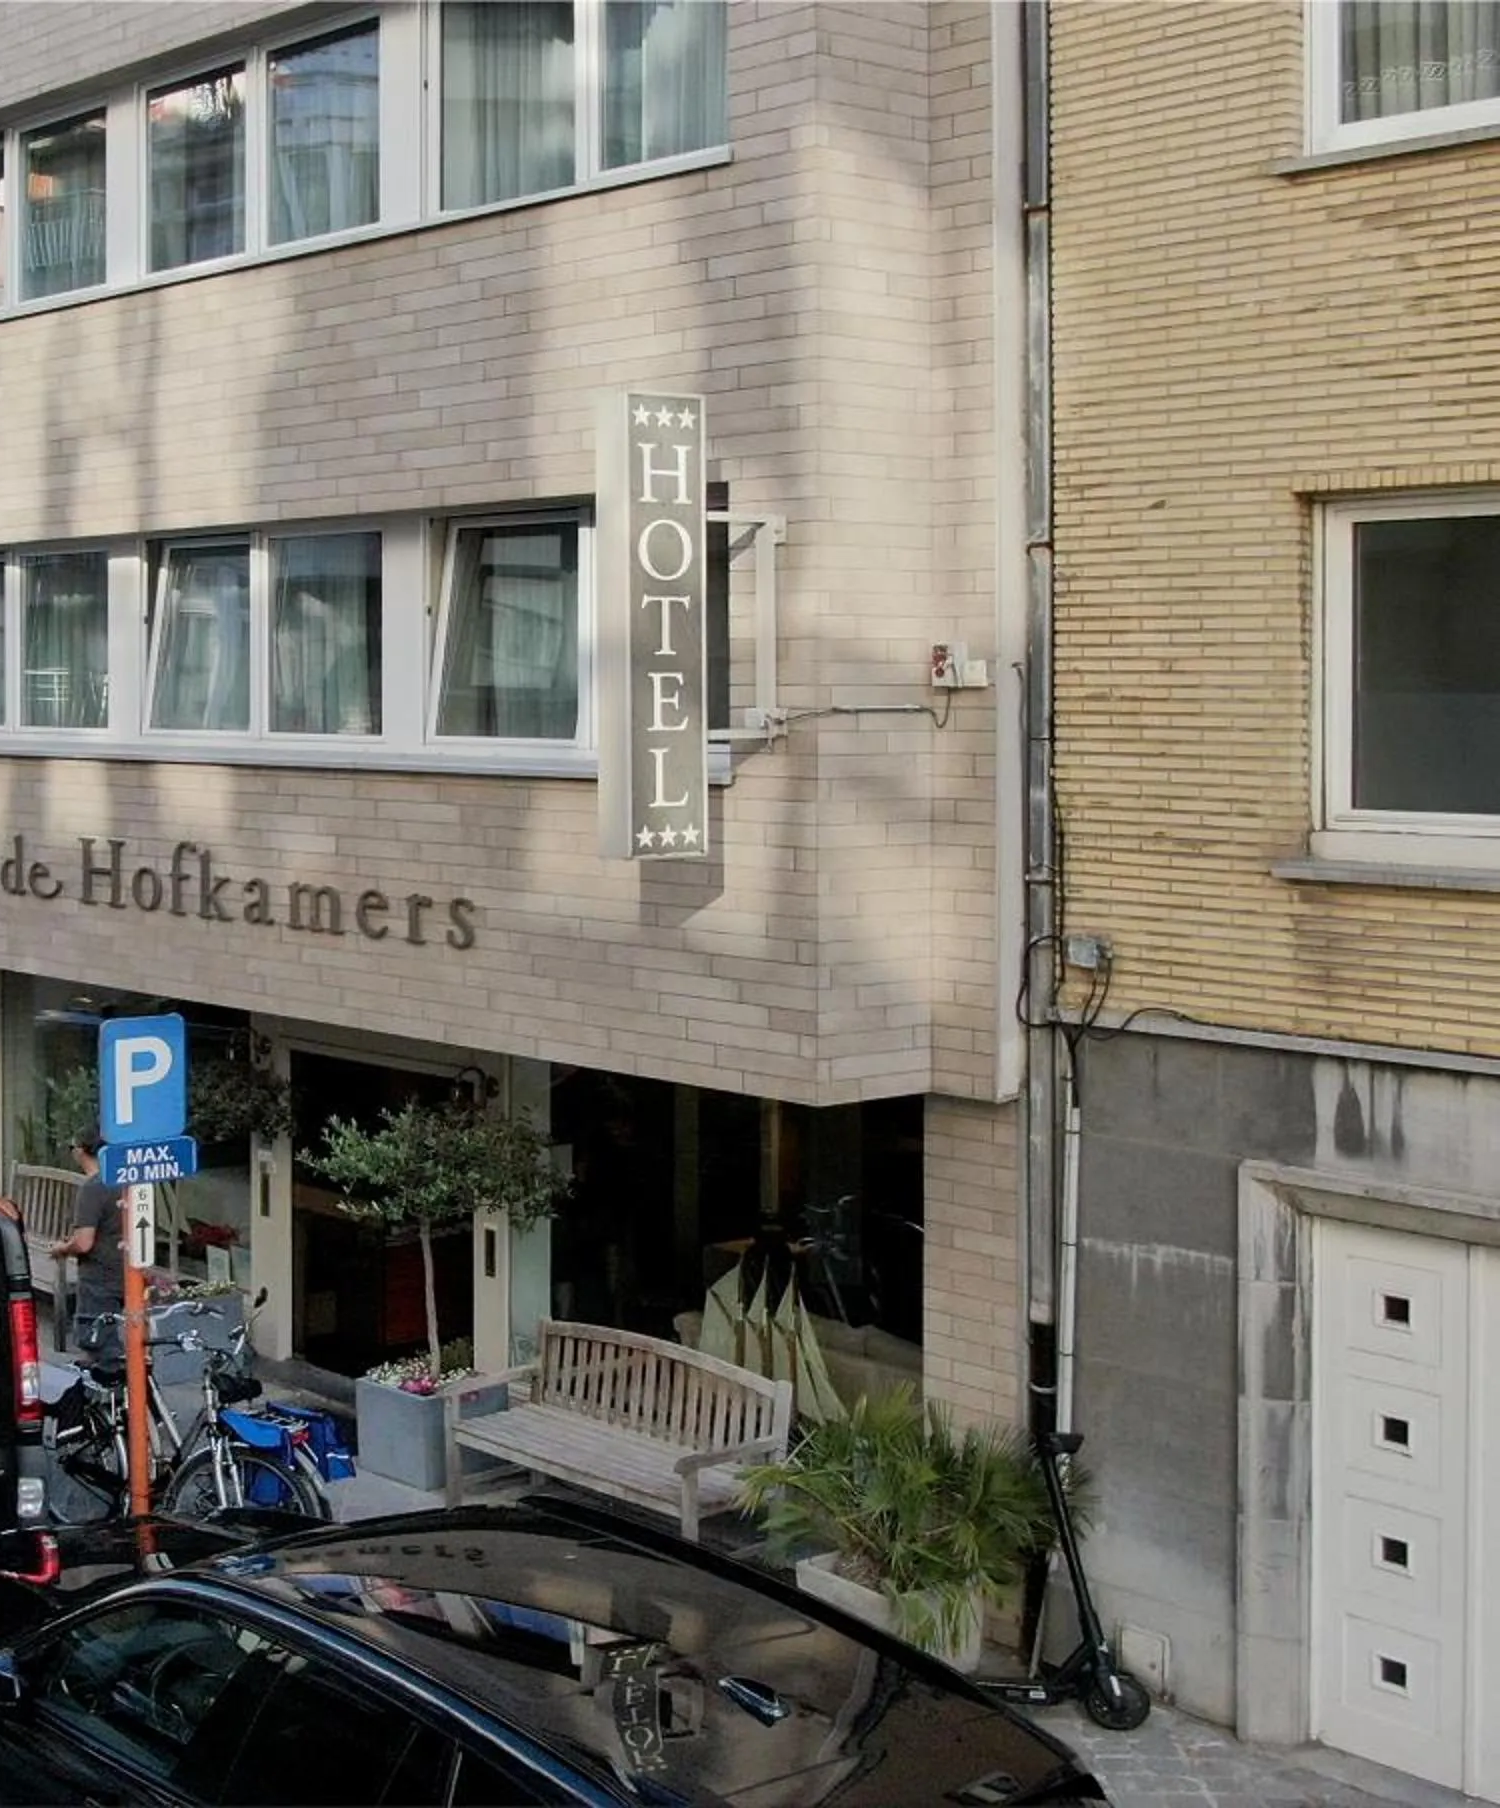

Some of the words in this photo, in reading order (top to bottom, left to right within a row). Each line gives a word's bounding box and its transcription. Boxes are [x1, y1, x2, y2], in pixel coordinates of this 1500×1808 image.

[636, 442, 694, 809] HOTEL
[0, 834, 64, 900] de
[78, 836, 477, 951] Hofkamers
[114, 1036, 173, 1125] P
[116, 1166, 139, 1184] 20
[143, 1161, 185, 1181] MIN.
[126, 1145, 175, 1165] MAX.
[136, 1203, 149, 1212] m
